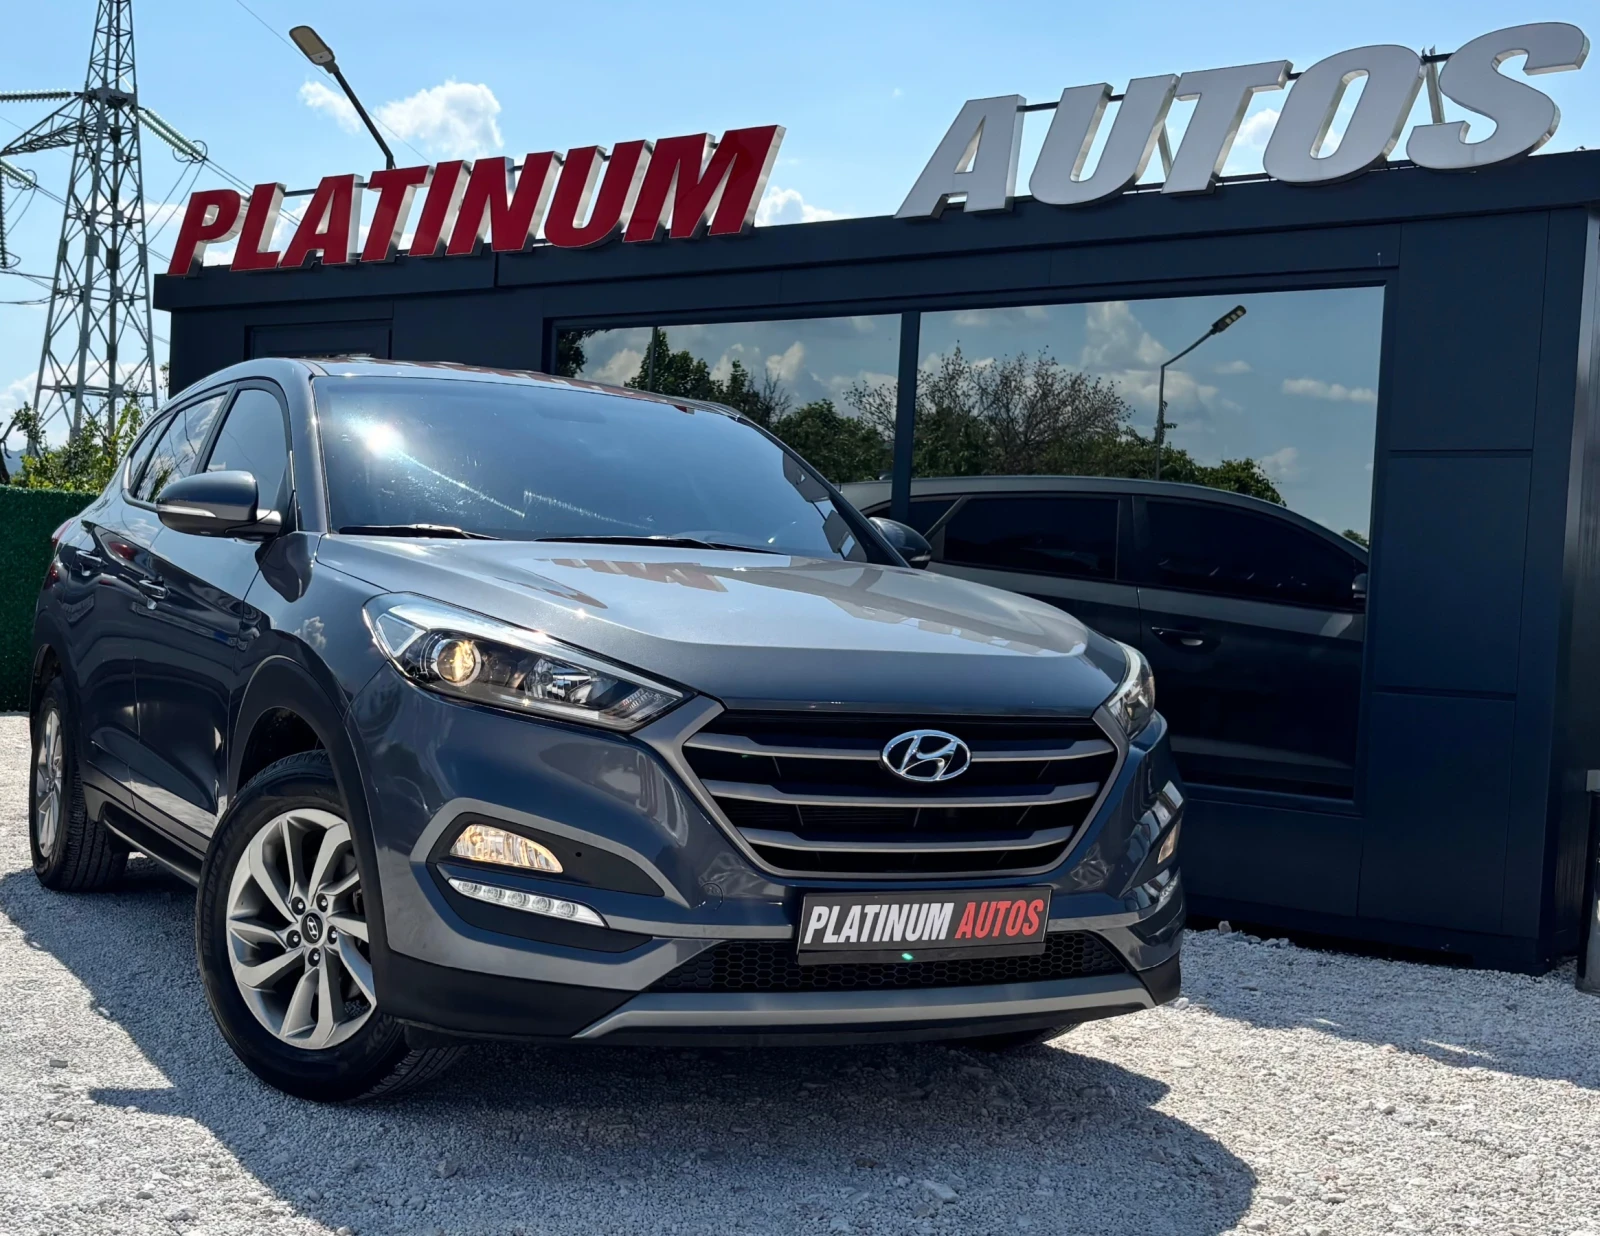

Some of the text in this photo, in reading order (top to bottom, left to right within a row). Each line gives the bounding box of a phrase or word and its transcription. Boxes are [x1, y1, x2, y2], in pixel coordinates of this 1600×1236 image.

[166, 22, 1590, 276] PLATINUM AUTOS
[803, 899, 1044, 944] PLATINUM AUTOS
